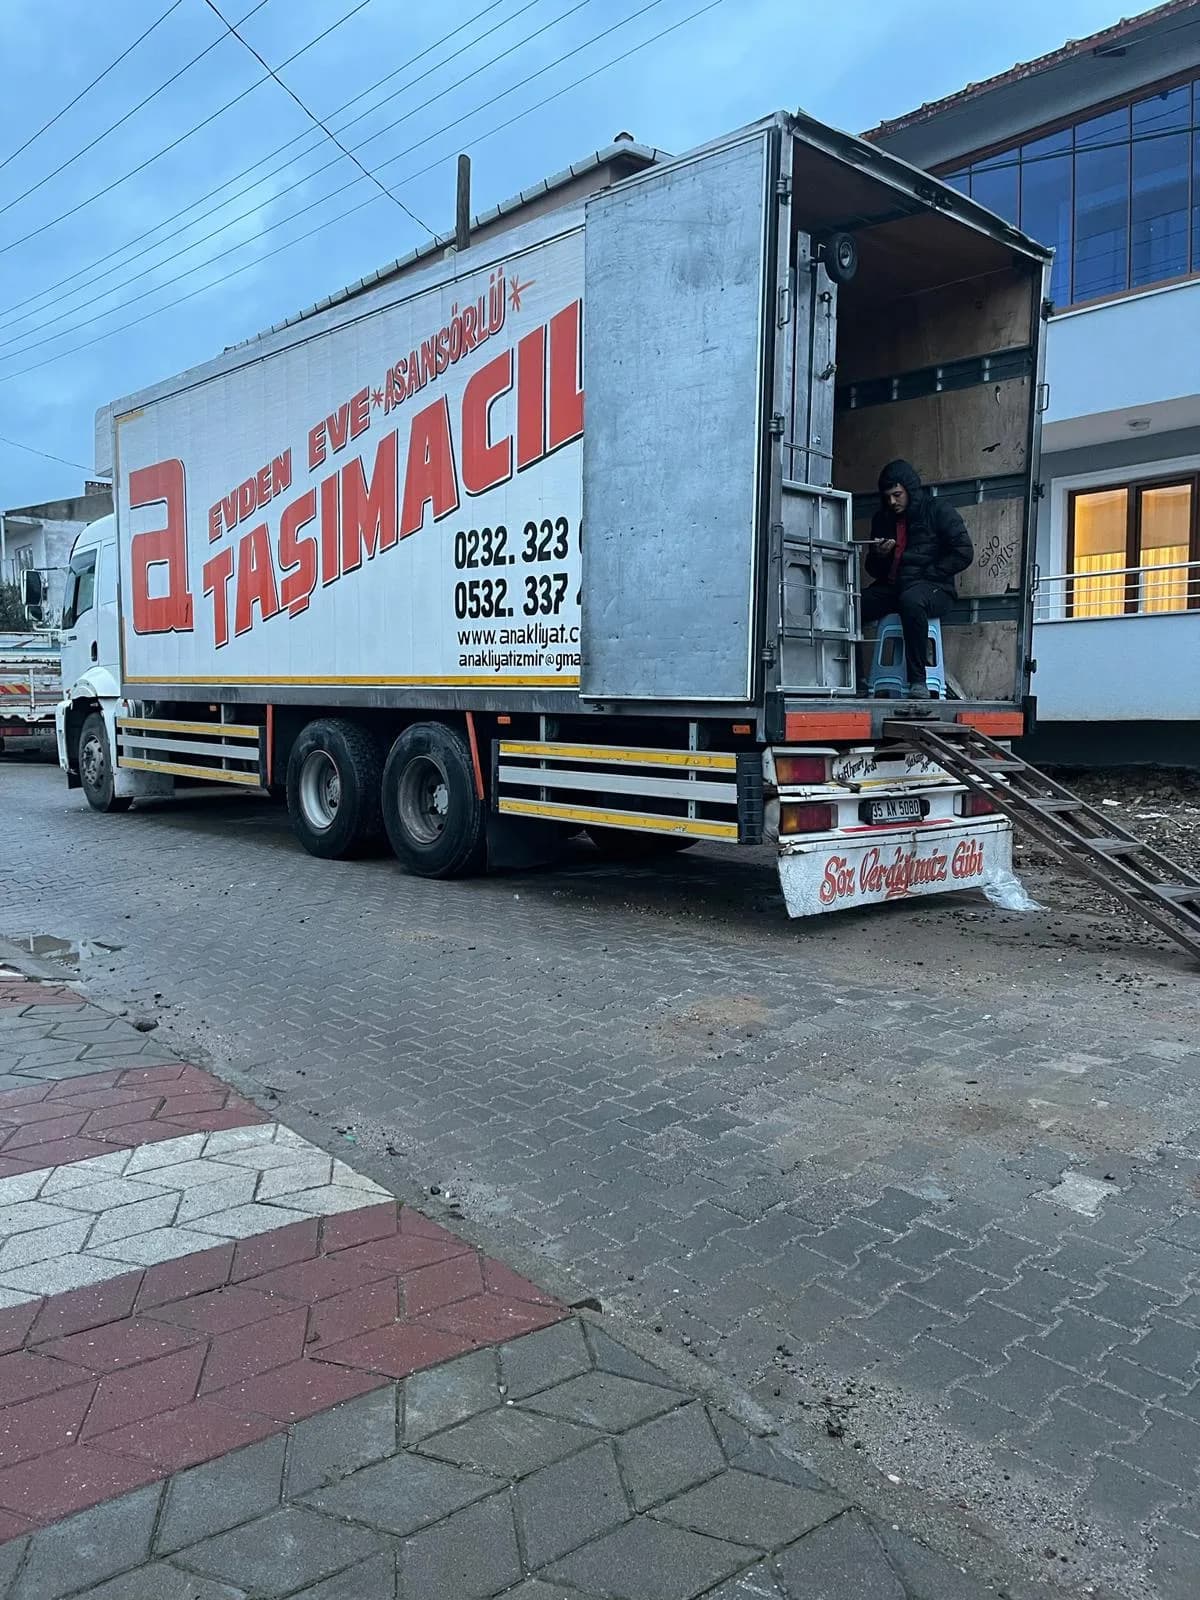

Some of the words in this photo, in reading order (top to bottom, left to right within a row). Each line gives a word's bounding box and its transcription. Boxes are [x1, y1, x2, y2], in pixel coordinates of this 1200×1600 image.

[208, 447, 292, 544] EVDEN
[308, 385, 370, 472] EVE
[384, 267, 506, 415] ASANSÖRLÜ
[455, 526, 515, 569] 0232.
[522, 517, 569, 563] 323
[455, 579, 514, 619] 0532.
[523, 573, 568, 616] 337
[872, 803, 883, 818] 35
[899, 799, 919, 815] 5080
[819, 856, 855, 904] Söz
[951, 839, 984, 879] Gibi
